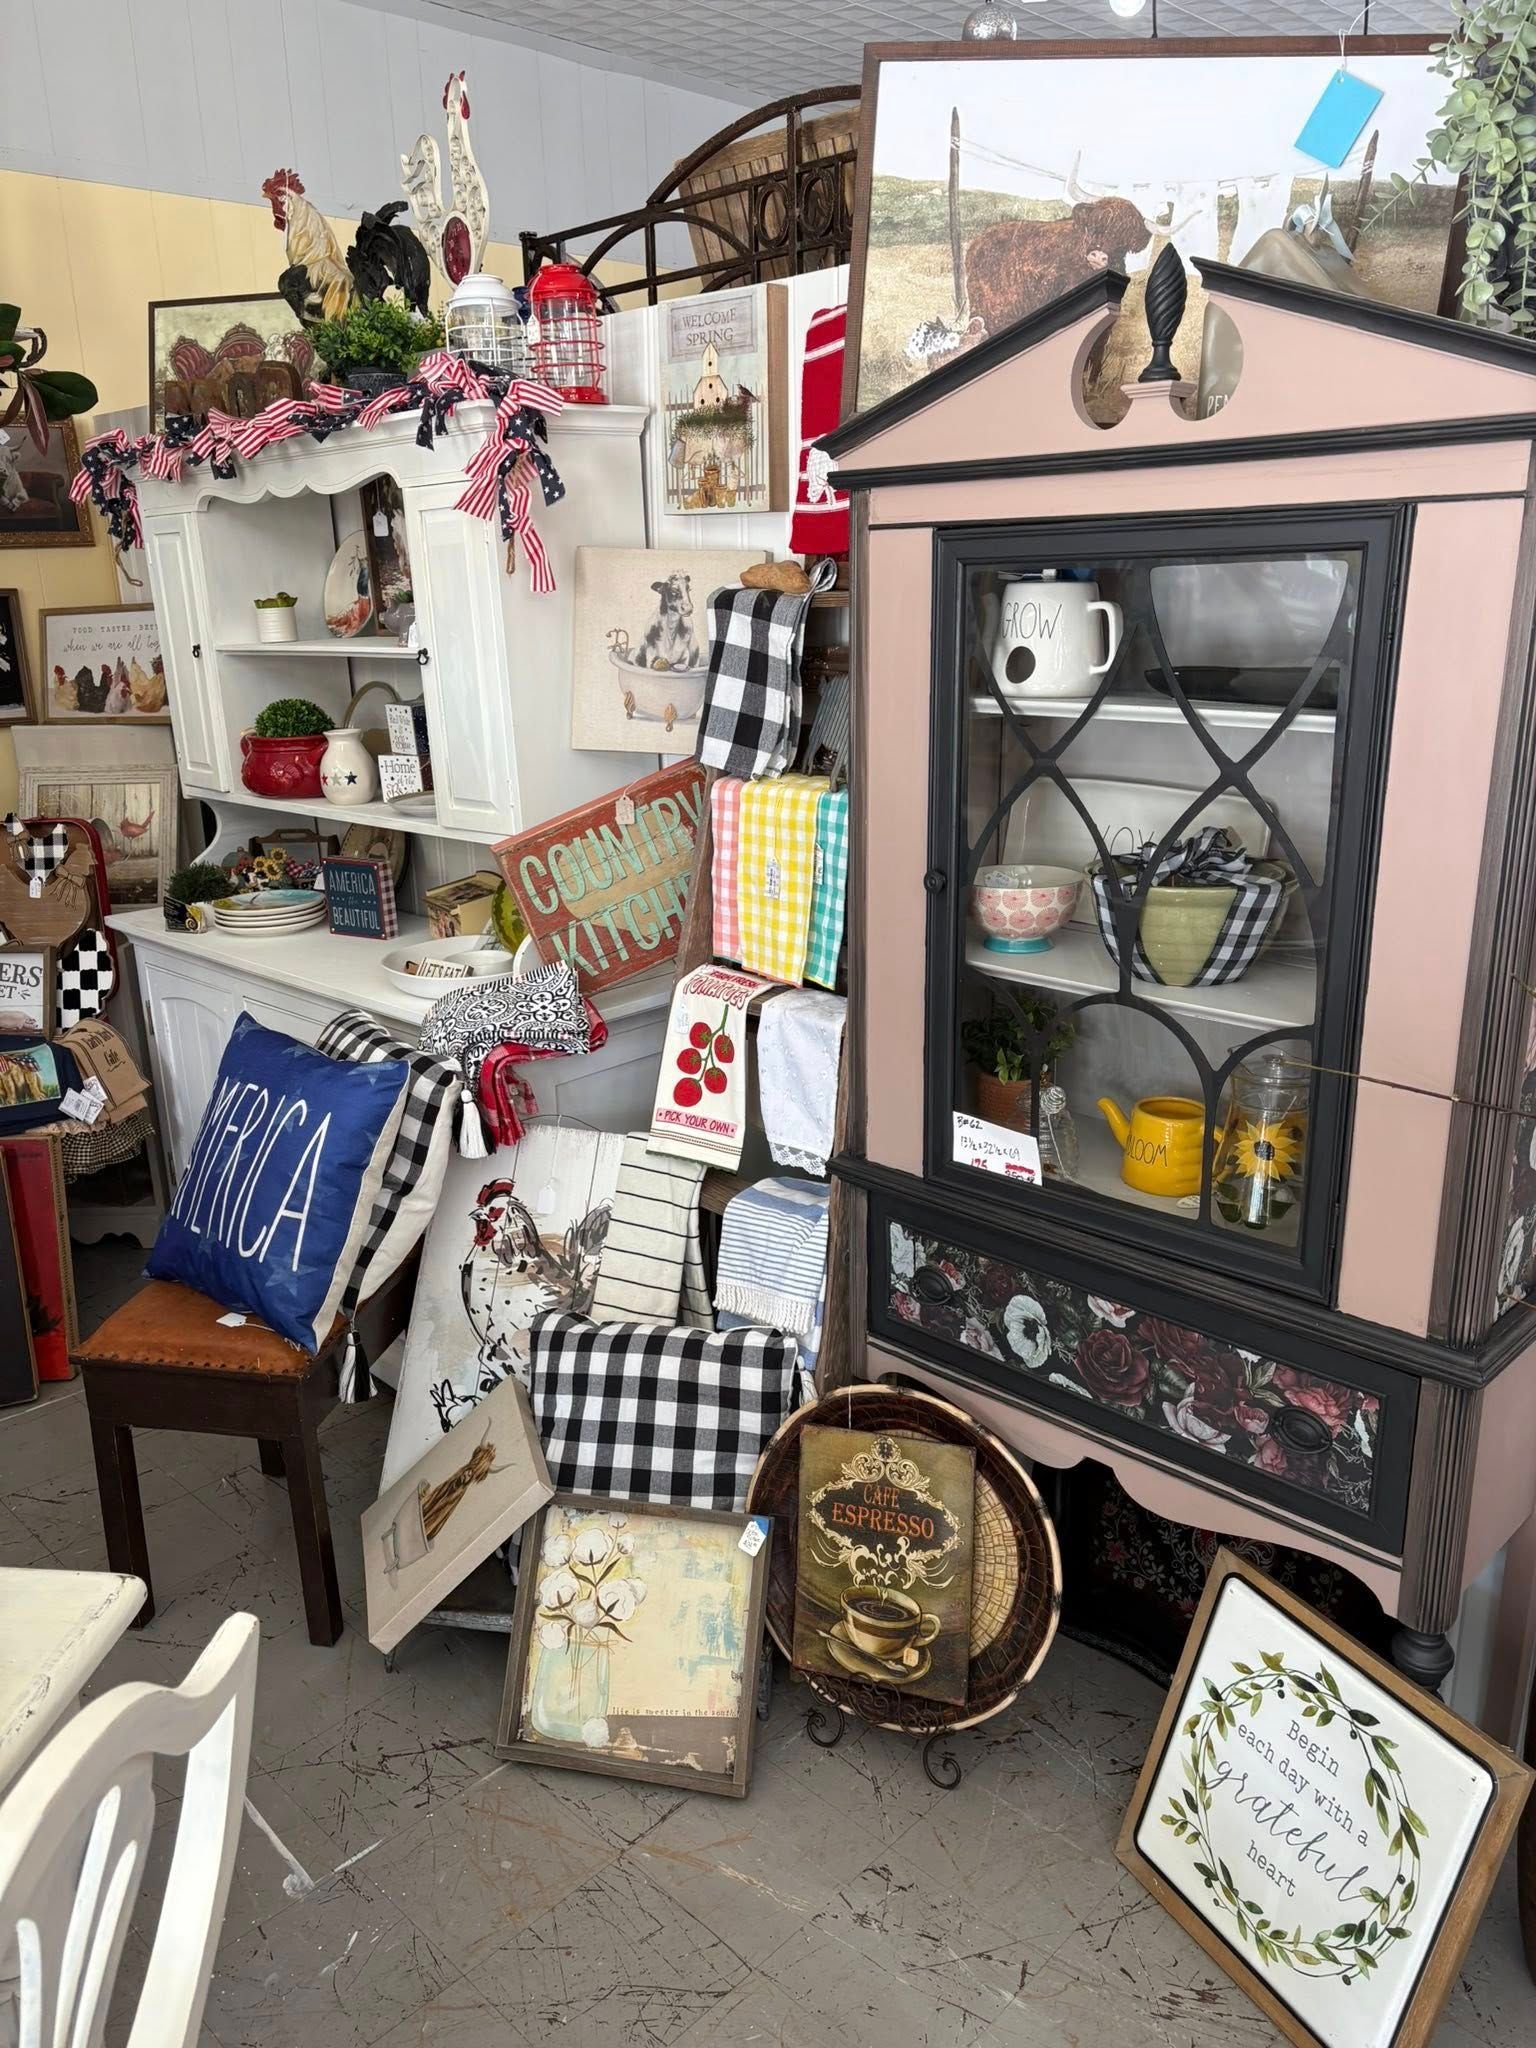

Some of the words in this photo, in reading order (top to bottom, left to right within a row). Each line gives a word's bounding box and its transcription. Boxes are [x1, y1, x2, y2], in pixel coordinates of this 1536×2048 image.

[682, 307, 737, 328] WELCOME
[686, 327, 734, 347] SPRING
[72, 626, 93, 634] FOOD
[100, 624, 131, 633] TASTES
[1001, 602, 1063, 639] GROW
[383, 760, 417, 774] Home
[519, 781, 701, 915] COUNTRY
[329, 870, 377, 896] AMERICA
[332, 906, 380, 930] BEAUTIFUL
[683, 974, 755, 1011] TOMATOES
[664, 1110, 682, 1123] PICK
[684, 1113, 707, 1129] YOUR
[709, 1120, 730, 1134] OWN
[1125, 1133, 1168, 1168] BLOOM
[171, 1076, 332, 1272] MERICA
[863, 1484, 900, 1508] CAFE
[832, 1502, 935, 1539] ESPRESSO
[1286, 1719, 1340, 1778] Begin
[1238, 1724, 1274, 1764] each
[1278, 1757, 1310, 1794] day
[1313, 1788, 1353, 1834] with
[1357, 1829, 1369, 1847] a
[1205, 1760, 1377, 1902] grateful
[1246, 1839, 1297, 1897] heart
